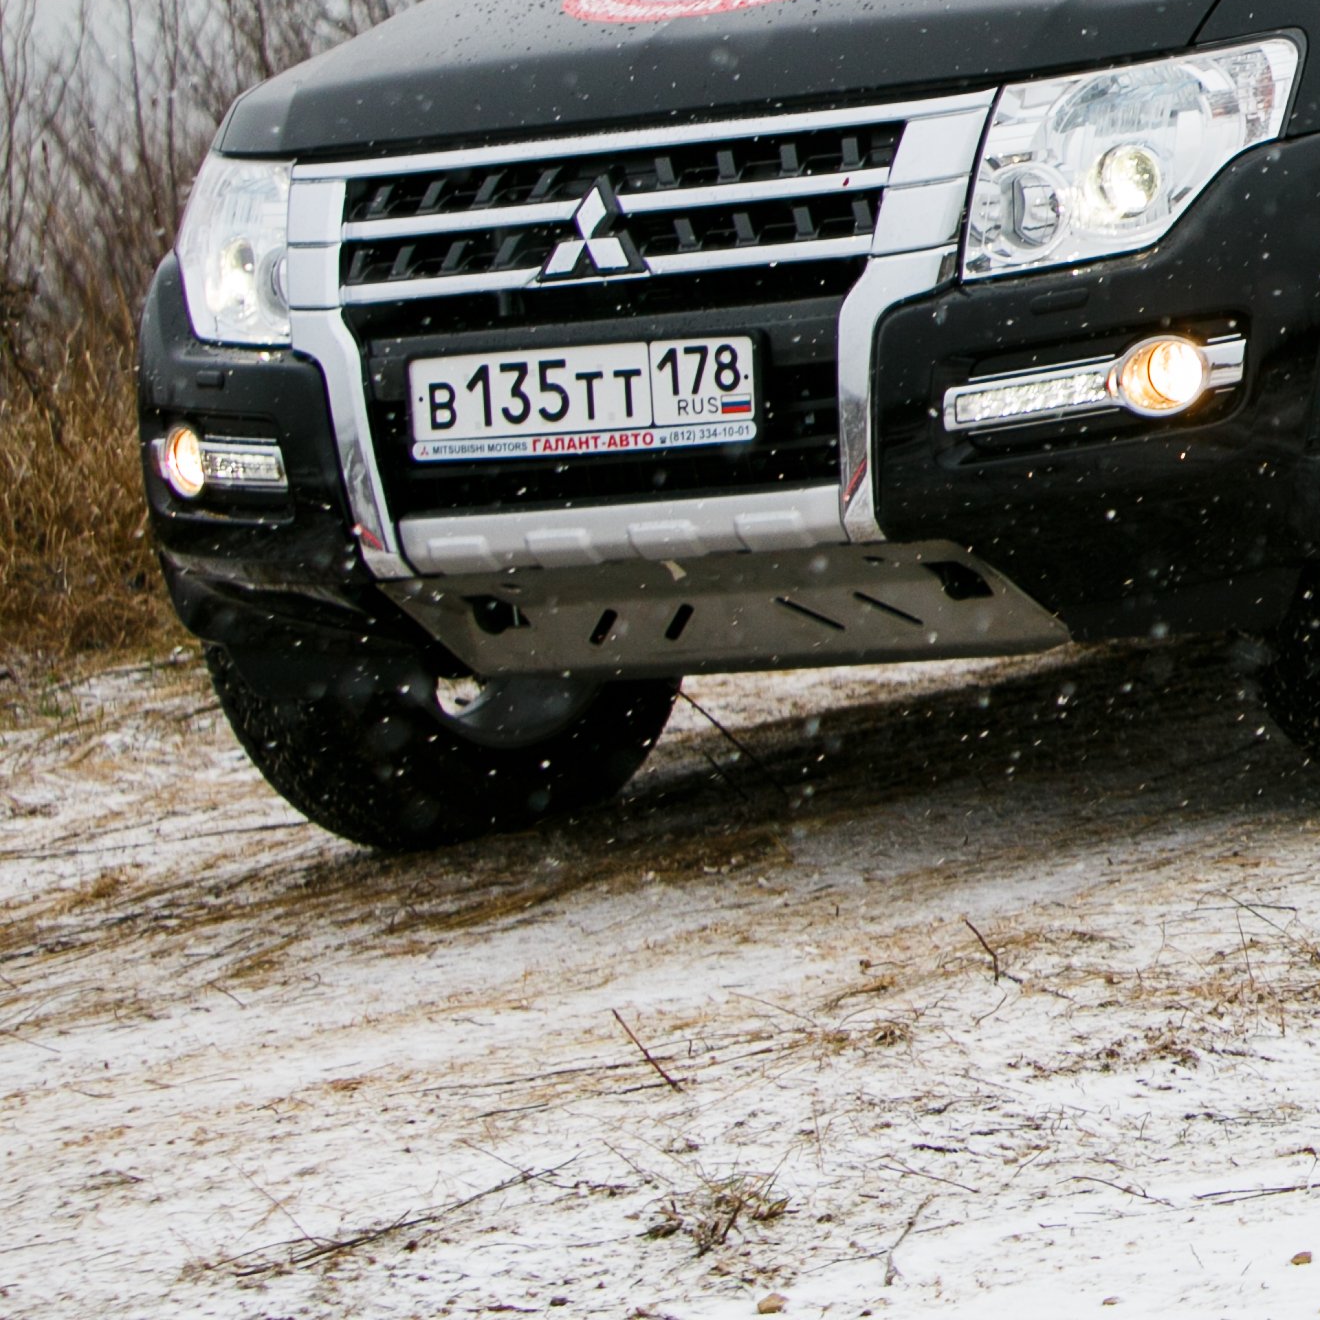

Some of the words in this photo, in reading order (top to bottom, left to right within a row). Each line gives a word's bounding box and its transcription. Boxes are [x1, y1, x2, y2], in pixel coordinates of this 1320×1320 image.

[656, 344, 742, 395] 178
[677, 397, 719, 417] RUS
[532, 432, 655, 453] ГАЛАНТ-АВТО
[669, 430, 697, 444] (812)
[699, 424, 751, 441] 334-10-01
[432, 443, 486, 455] MITSUBISHI
[487, 442, 528, 453] MOTORS
